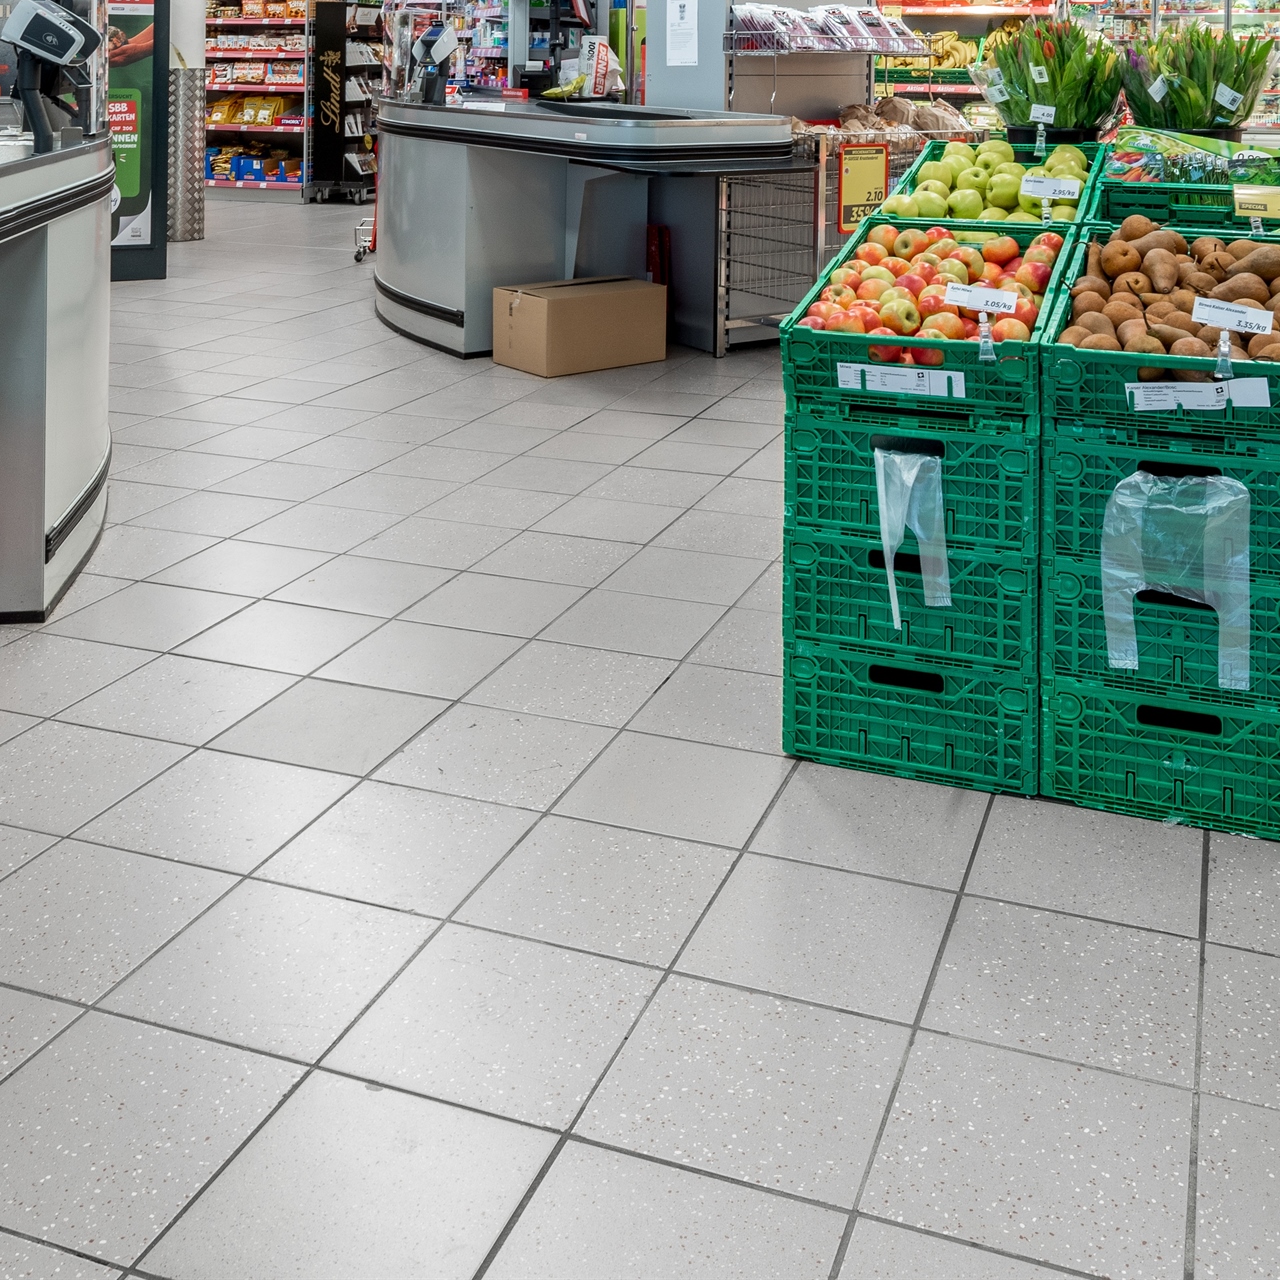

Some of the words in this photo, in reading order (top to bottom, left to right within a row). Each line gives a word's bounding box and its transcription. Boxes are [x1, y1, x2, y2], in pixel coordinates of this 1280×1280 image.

[587, 41, 596, 61] 100%
[595, 45, 608, 94] DENNER
[320, 66, 340, 133] Lindt
[108, 103, 128, 112] SBB
[866, 191, 883, 202] 2.10
[984, 299, 1012, 311] 3.05/kg
[1225, 306, 1248, 315] Alexander
[1236, 319, 1267, 331] 3.35/kg
